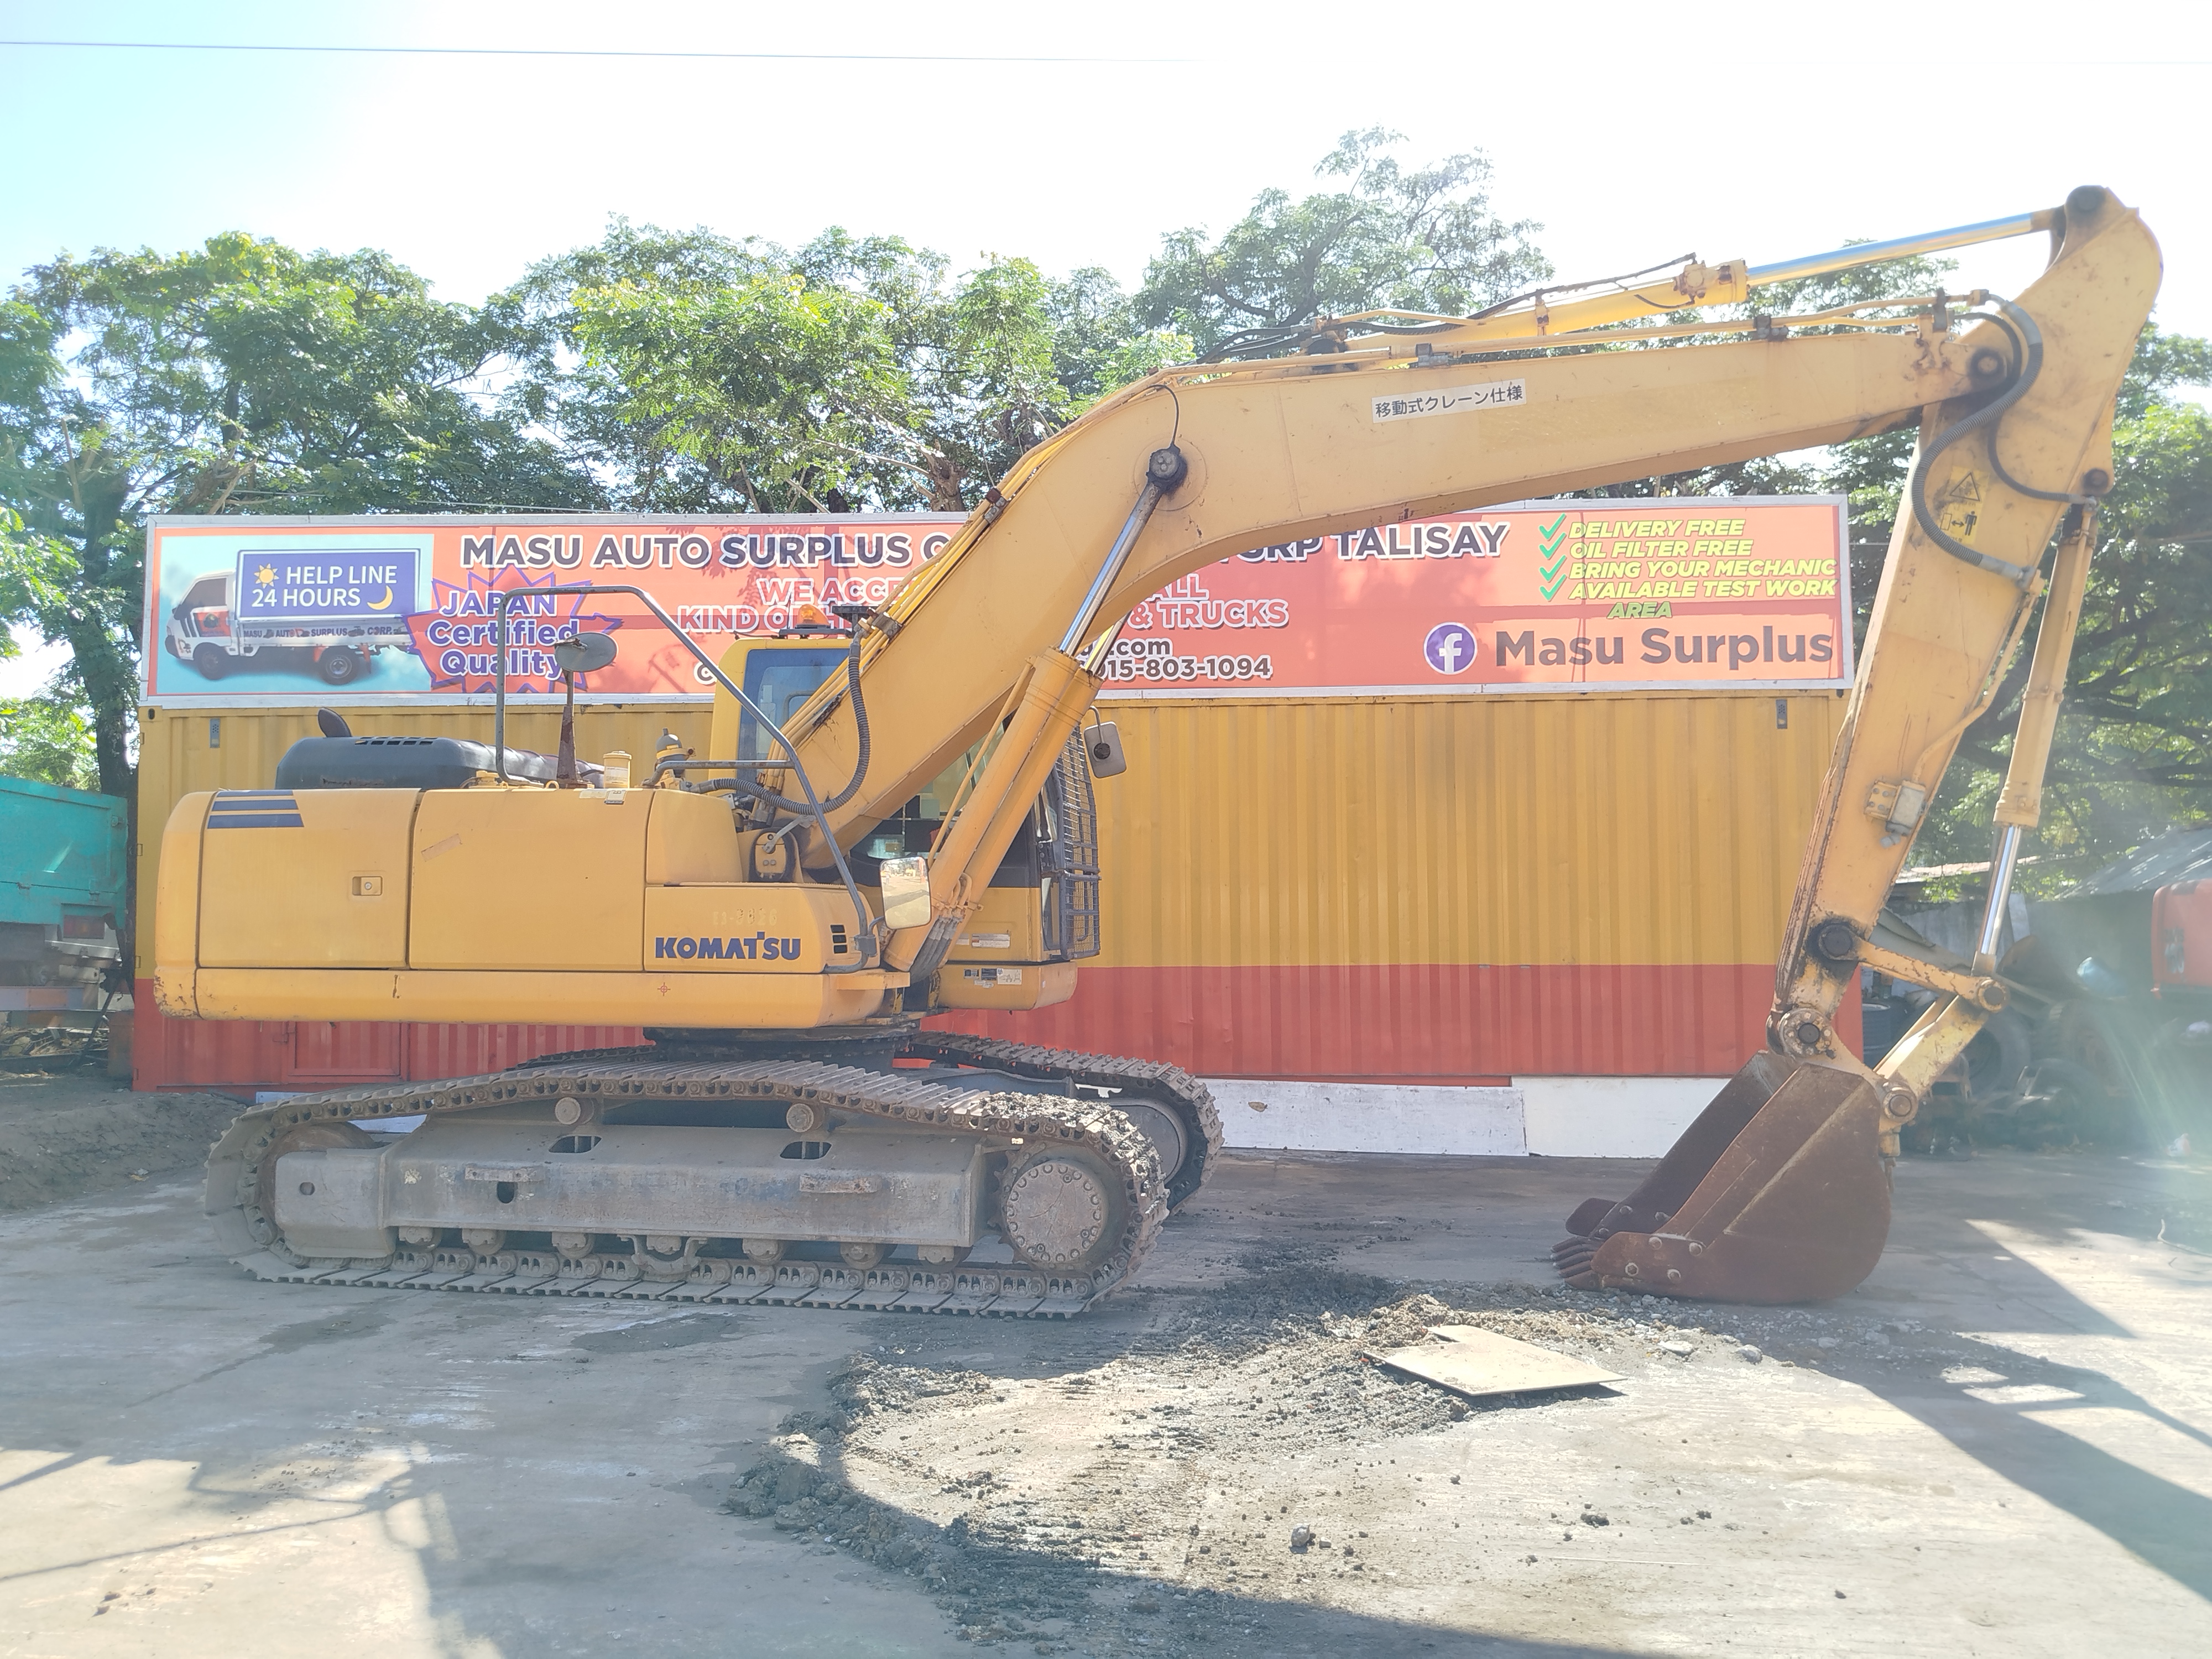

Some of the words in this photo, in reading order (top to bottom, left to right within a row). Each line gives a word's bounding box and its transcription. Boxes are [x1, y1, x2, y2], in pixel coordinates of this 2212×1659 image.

[1374, 384, 1524, 418] 移動式クレーン仕様
[1568, 519, 1683, 539] DELIVERY
[1683, 518, 1746, 538] FREE
[462, 536, 582, 567] MASU
[592, 536, 710, 567] AUTO
[721, 534, 911, 566] SURPLUS
[1331, 524, 1509, 556] TALISAY
[1569, 540, 1608, 559] OIL
[1610, 540, 1691, 558] FILTER
[1692, 539, 1754, 557] FREE
[286, 565, 343, 585] HELP
[348, 565, 398, 584] LINE
[1569, 561, 1641, 580] BRING
[1646, 560, 1710, 578] YOUR
[1713, 558, 1838, 577] MECHANIC
[251, 588, 278, 607] 24
[283, 587, 361, 607] HOURS
[760, 580, 813, 603] WE
[1568, 580, 1698, 599] AVAILABLE
[1702, 579, 1761, 597] TEST
[1765, 578, 1838, 596] WORK
[441, 591, 556, 615] JAPAN
[1159, 602, 1288, 626] TRUCKS
[1606, 600, 1673, 619] AREA
[680, 607, 755, 629] KIND
[243, 630, 263, 638] MASU
[311, 628, 348, 637] SURPLUS
[430, 619, 580, 645] Certified
[1495, 630, 1624, 666] Masu
[1639, 625, 1834, 671] Surplus
[655, 931, 801, 961] KOMATSU
